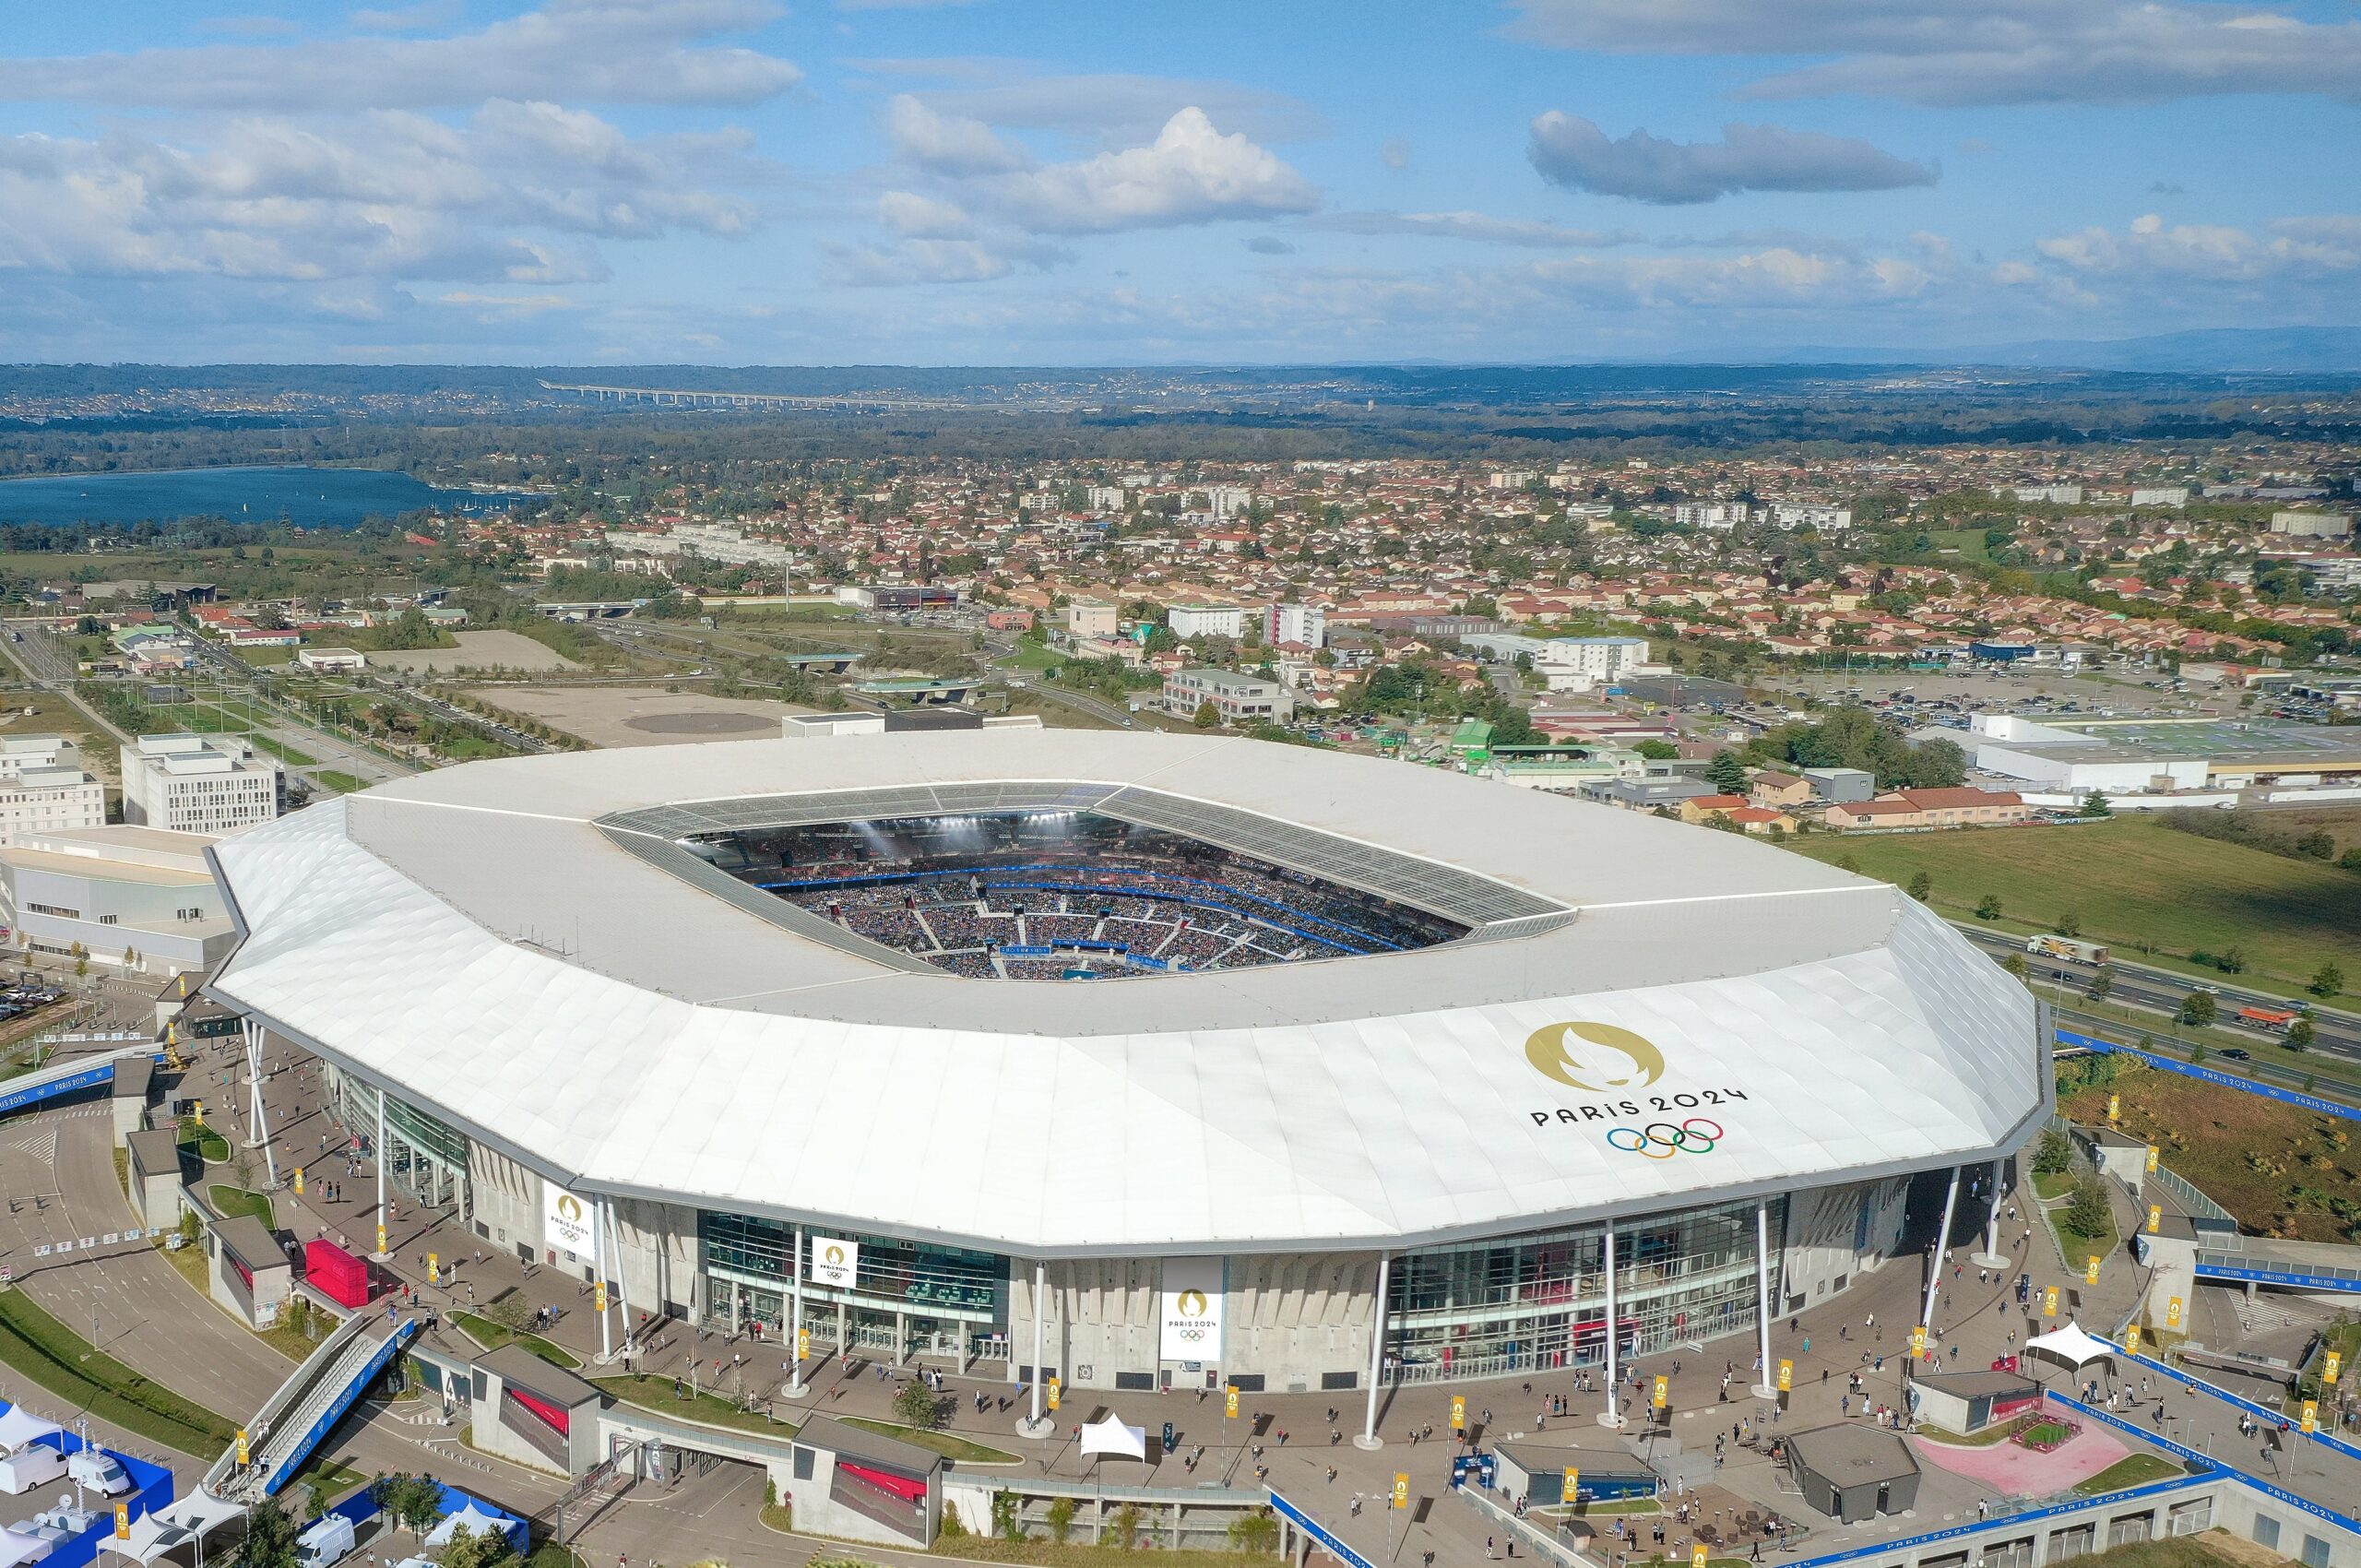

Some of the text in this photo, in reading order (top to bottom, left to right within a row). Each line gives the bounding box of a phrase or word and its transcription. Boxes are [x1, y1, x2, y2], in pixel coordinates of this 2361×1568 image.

[2202, 1071, 2252, 1089] PARIS 2024
[1530, 1088, 1749, 1127] PARIS 2024
[2295, 1096, 2345, 1115] PARIS 2024
[551, 1216, 588, 1235] PARIS 2024
[445, 1376, 454, 1397] 4
[2085, 1407, 2126, 1430] PARIS 2024
[2165, 1442, 2216, 1469] PARIS 2024
[2048, 1491, 2135, 1515] PARIS 2024
[2268, 1486, 2334, 1521] PARIS 2024
[1323, 1534, 1347, 1556] PARIS
[1887, 1526, 1972, 1550] PARIS 2024
